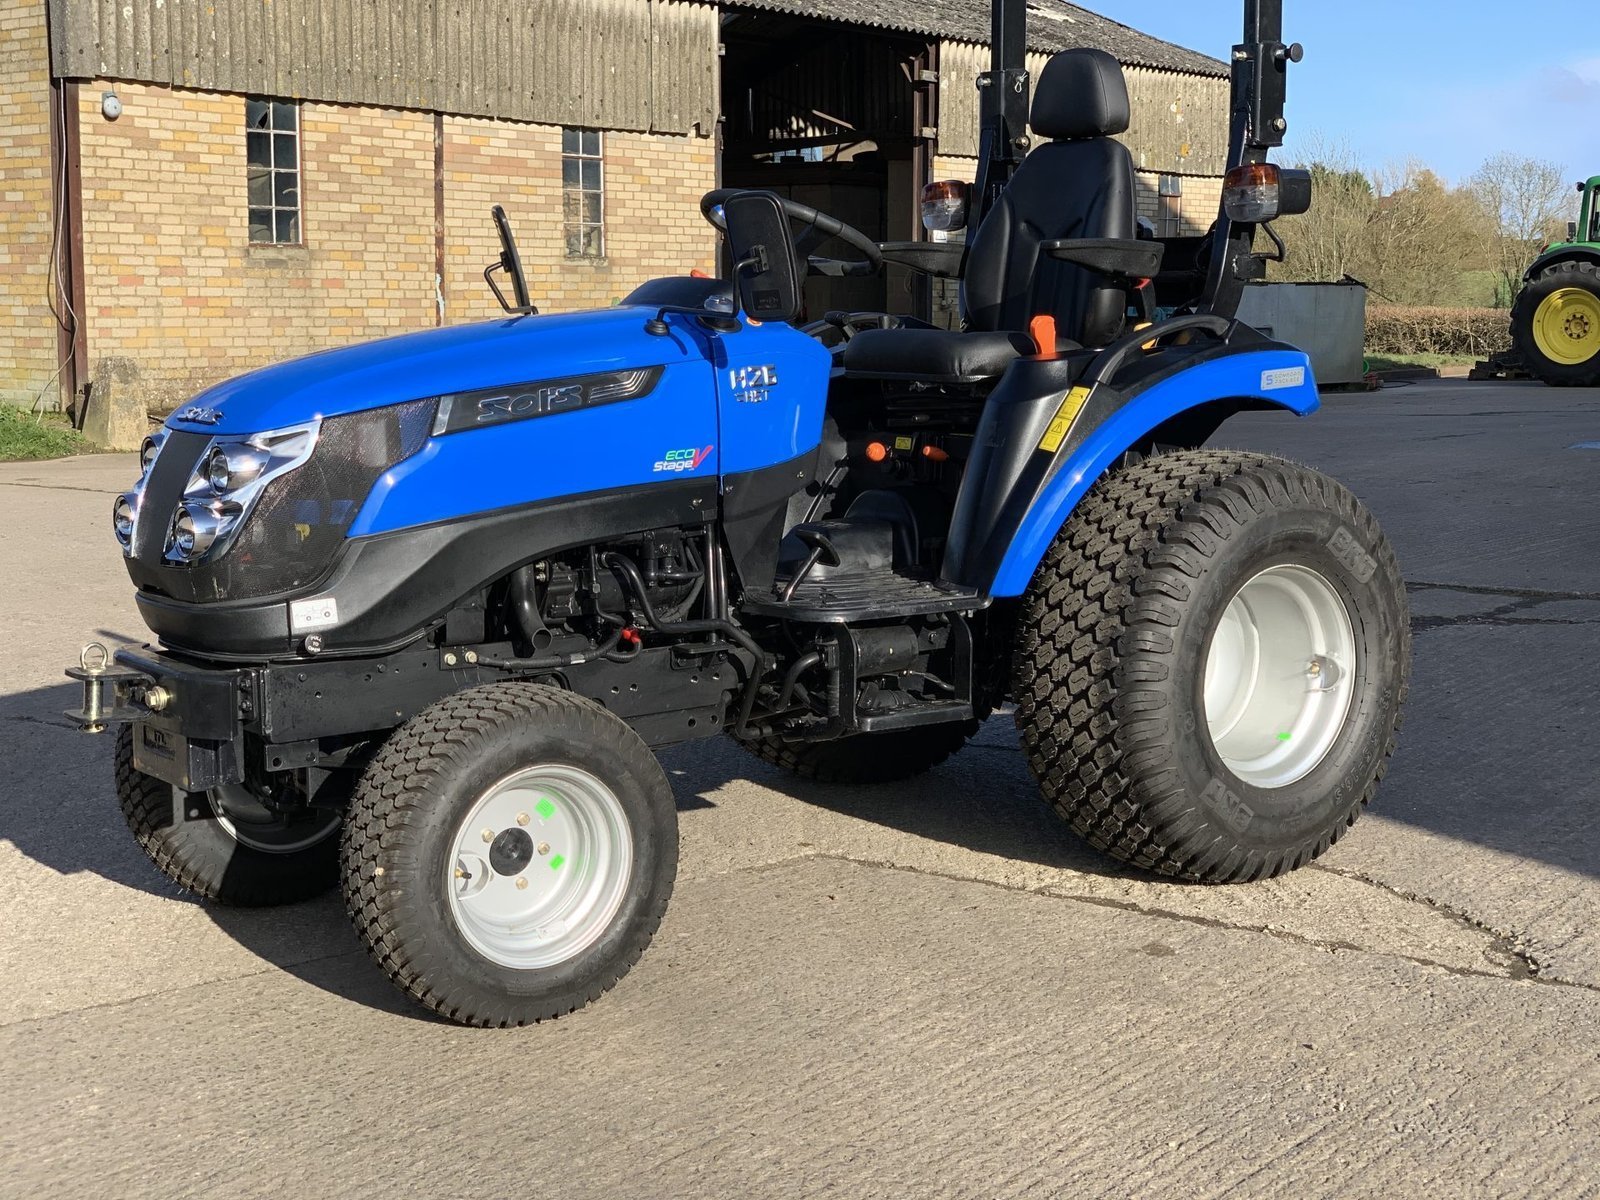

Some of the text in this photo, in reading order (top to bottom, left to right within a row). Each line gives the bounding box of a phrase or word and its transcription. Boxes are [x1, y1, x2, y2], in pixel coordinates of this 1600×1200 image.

[730, 364, 777, 390] H26
[653, 444, 714, 472] Stage V
[665, 448, 696, 461] ECO
